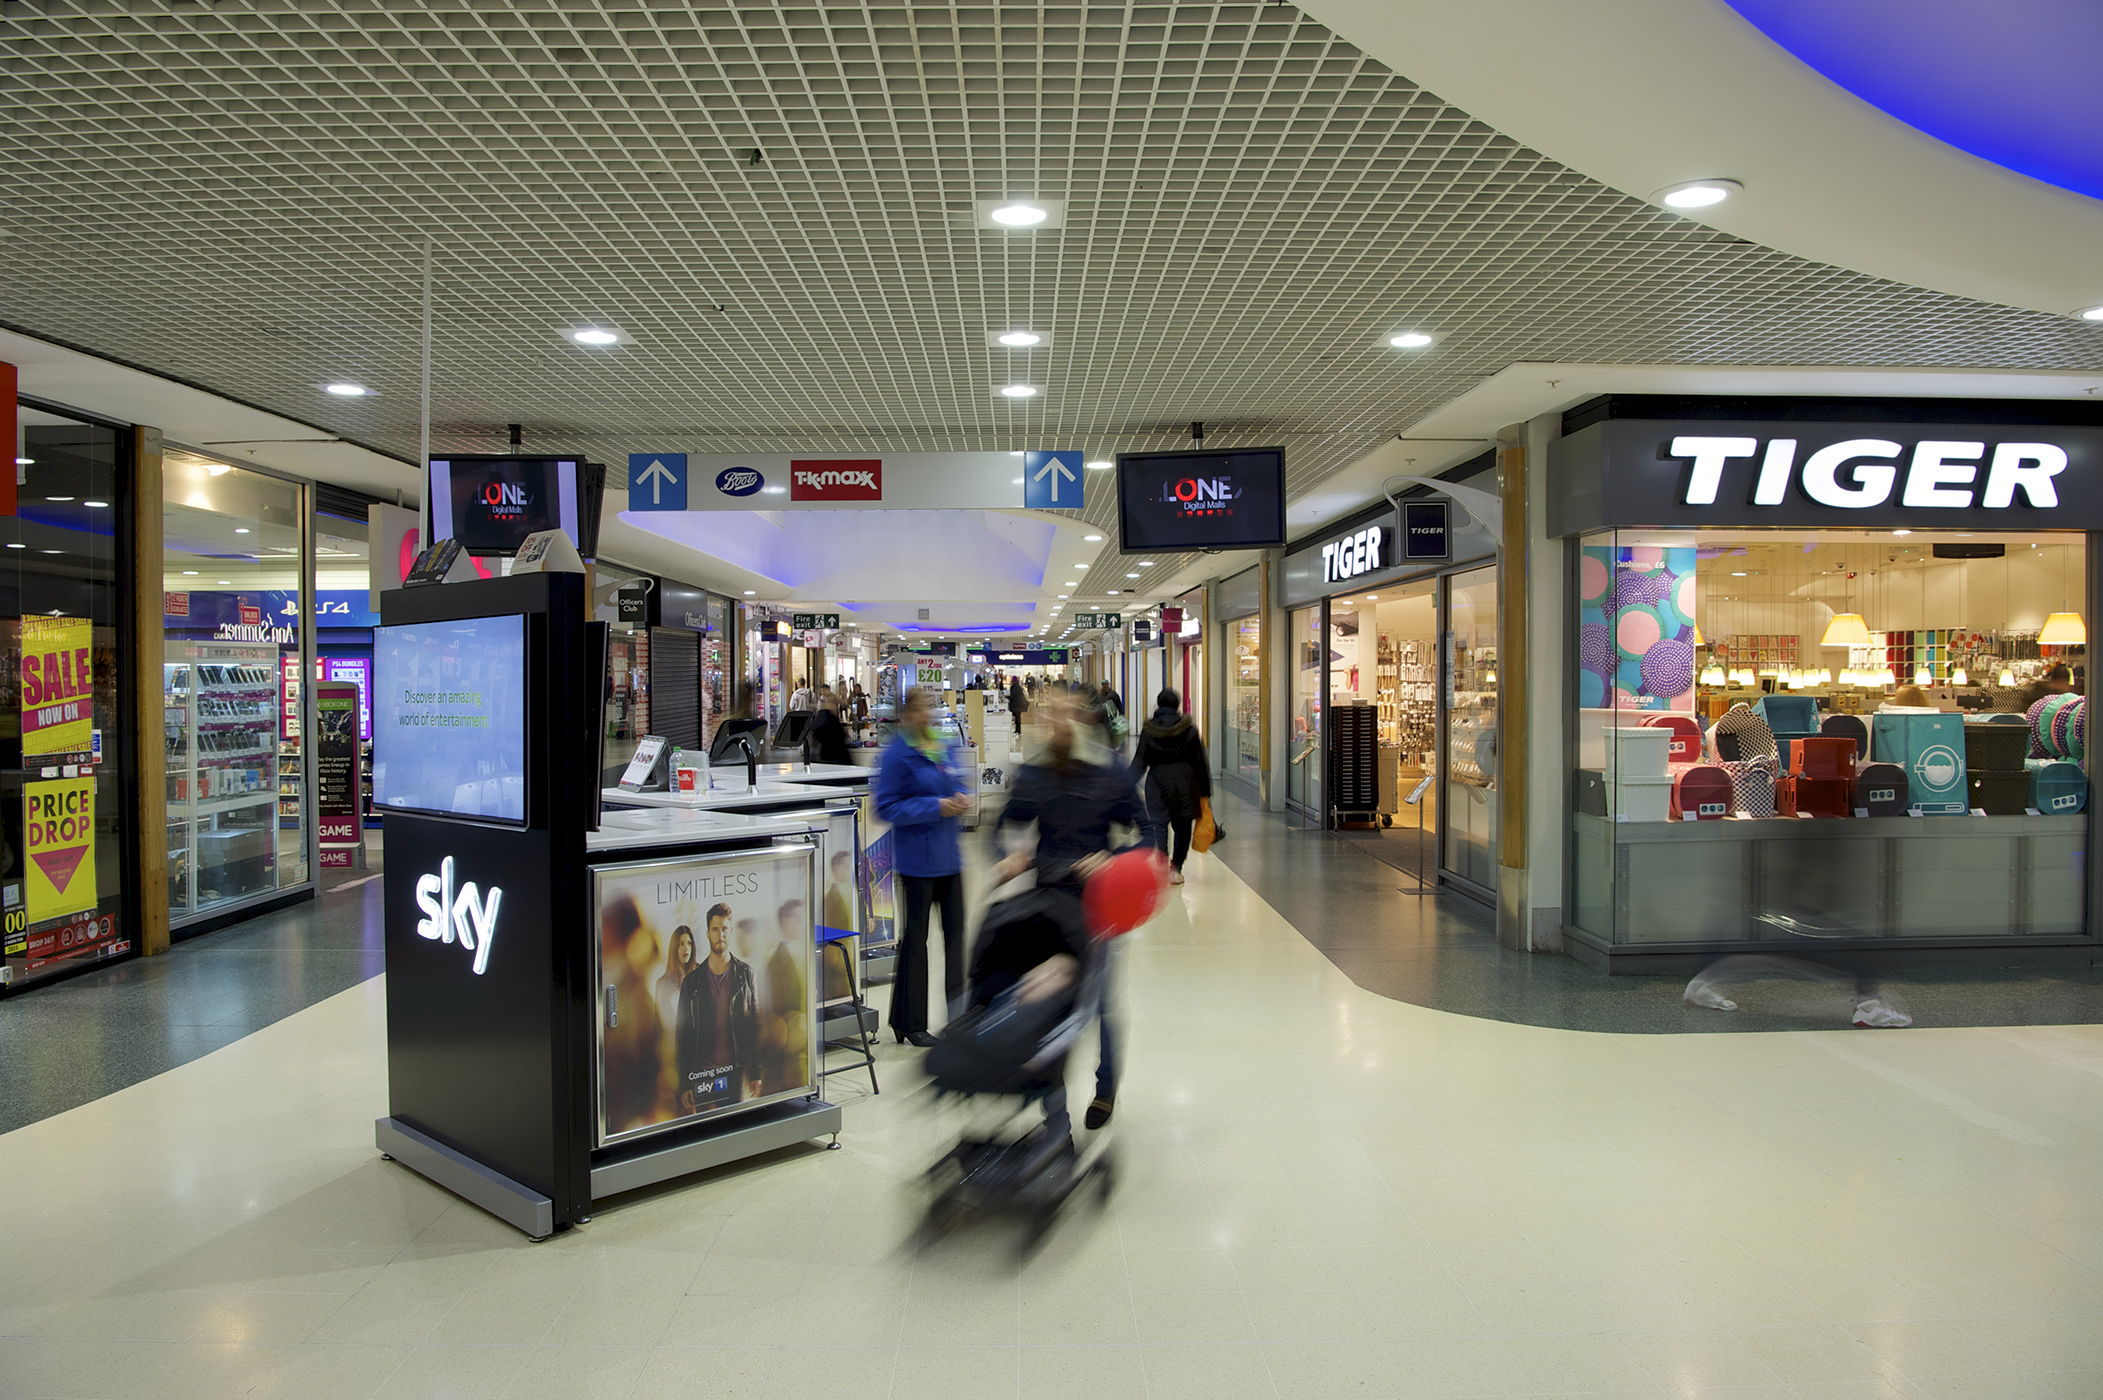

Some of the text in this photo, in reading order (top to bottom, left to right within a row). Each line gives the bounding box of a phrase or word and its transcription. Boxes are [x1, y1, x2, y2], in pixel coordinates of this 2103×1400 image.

[1670, 436, 2069, 508] TIGER
[720, 472, 757, 491] Boots
[492, 505, 523, 515] Digital Malls
[1183, 501, 1226, 511] Digital Malls
[1410, 527, 1444, 535] TIGER
[1322, 526, 1381, 583] TIGER
[316, 602, 350, 614] S4
[928, 658, 934, 668] 2
[22, 648, 92, 706] SALE
[918, 669, 942, 682] £20
[404, 690, 481, 708] Discover an amazing
[1619, 695, 1654, 703] TIGER
[38, 702, 78, 727] NOW ON
[400, 711, 489, 729] world of entertainment
[28, 790, 89, 820] PRICE
[29, 815, 90, 847] DROP
[319, 825, 352, 836] GAME
[320, 853, 347, 862] GAME
[657, 872, 758, 904] LIMITLESS
[416, 855, 502, 975] sky
[688, 1064, 734, 1080] Coming soon
[697, 1082, 714, 1093] sky
